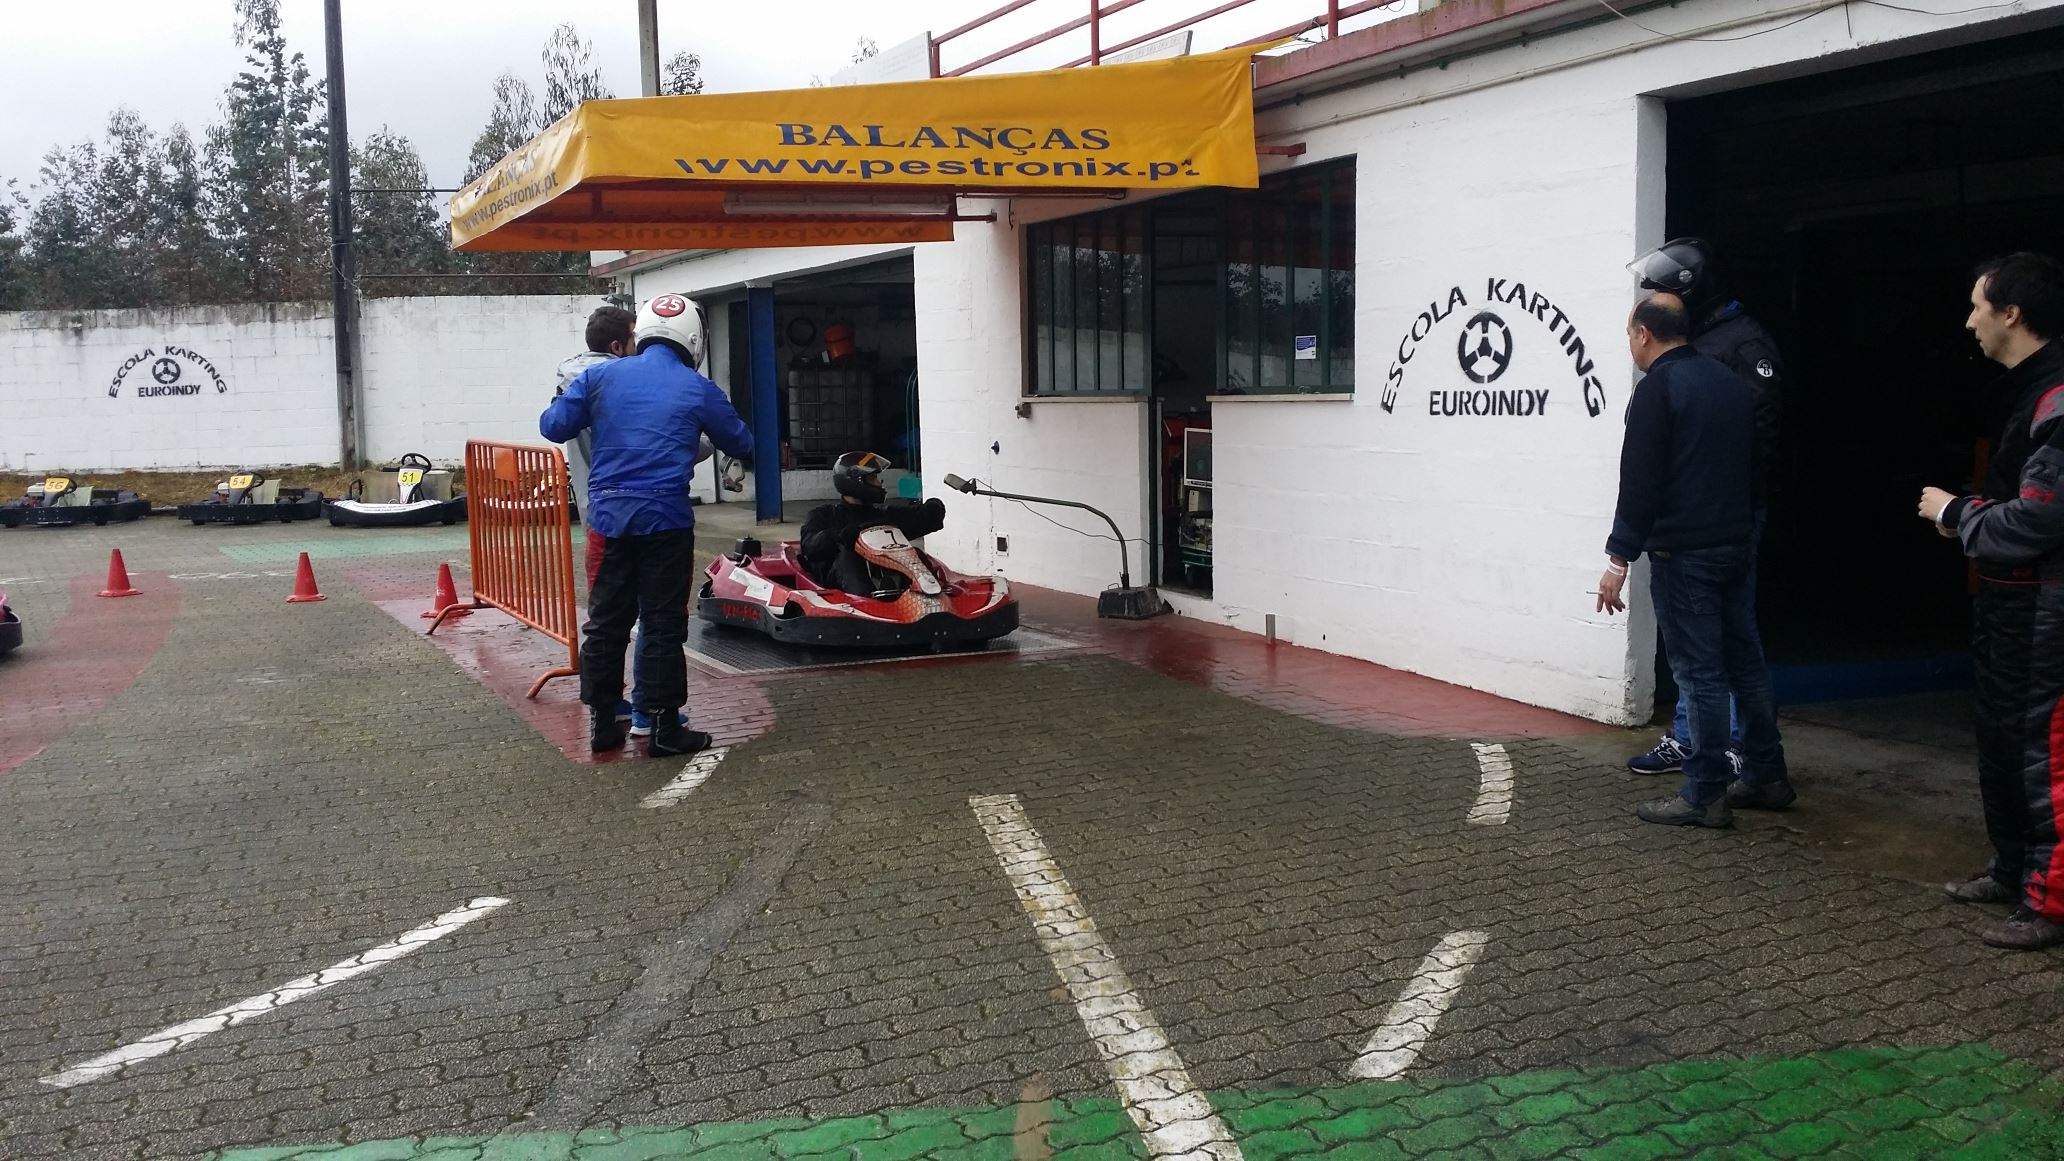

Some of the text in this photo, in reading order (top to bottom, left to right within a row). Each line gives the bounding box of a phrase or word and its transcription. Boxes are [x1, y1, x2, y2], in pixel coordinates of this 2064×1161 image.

[776, 123, 1111, 155] BALANÇAS
[656, 297, 682, 311] 25
[1380, 277, 1607, 418] ESCOLA KARTING
[108, 345, 228, 399] ESCOLA KARTING
[138, 384, 202, 398] EUROINDY
[1428, 389, 1550, 417] EUROINDY
[232, 477, 246, 486] 54
[401, 471, 415, 483] 51
[46, 481, 65, 490] 56
